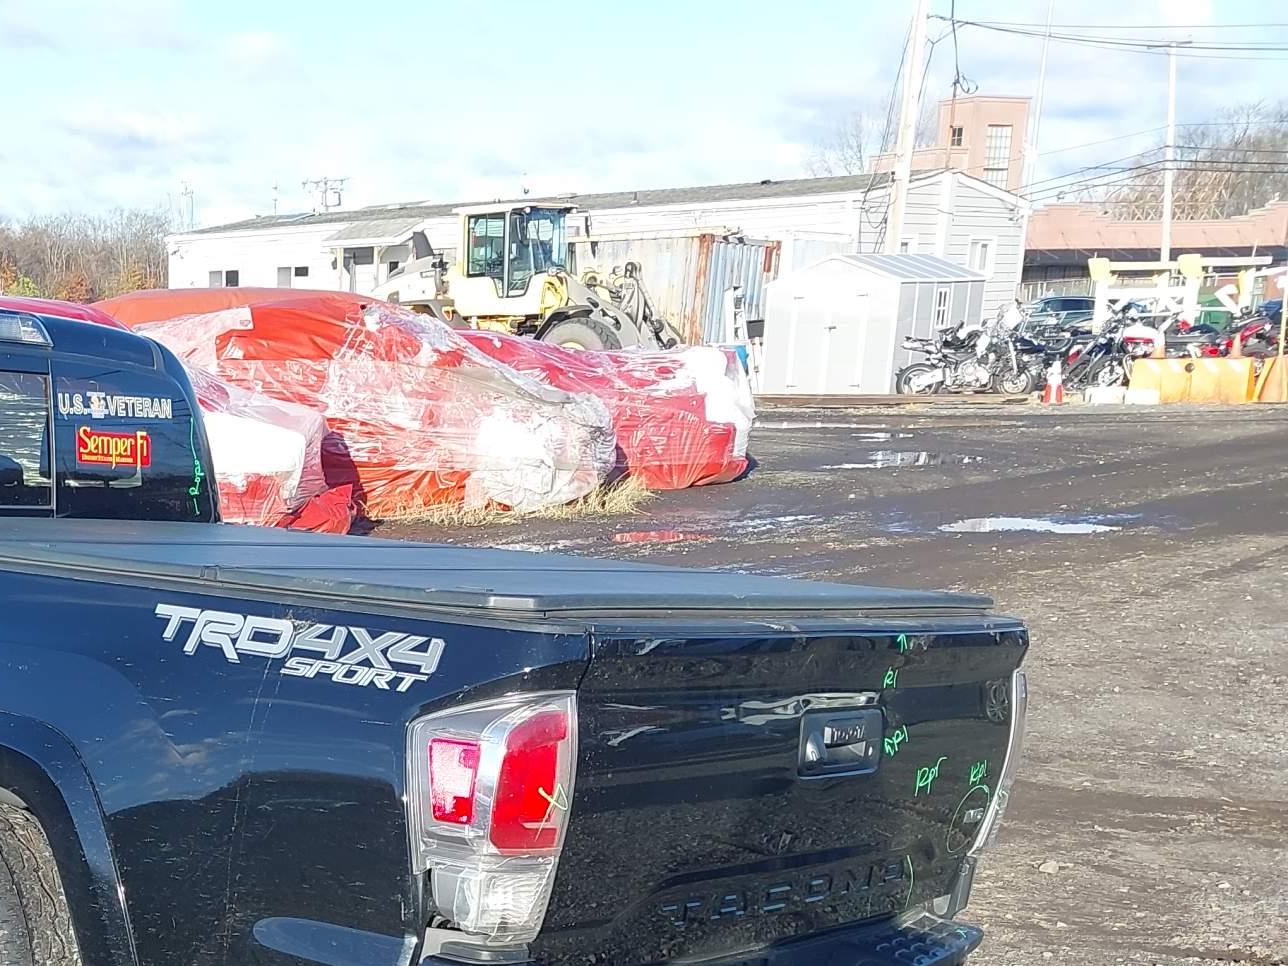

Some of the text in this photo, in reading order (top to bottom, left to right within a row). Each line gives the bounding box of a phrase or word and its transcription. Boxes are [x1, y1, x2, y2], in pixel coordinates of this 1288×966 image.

[57, 393, 172, 419] U.S. VETERAN
[79, 426, 134, 470] Semper
[153, 602, 295, 664] TRD
[279, 656, 429, 693] SPORT
[662, 858, 905, 928] TACOMA
